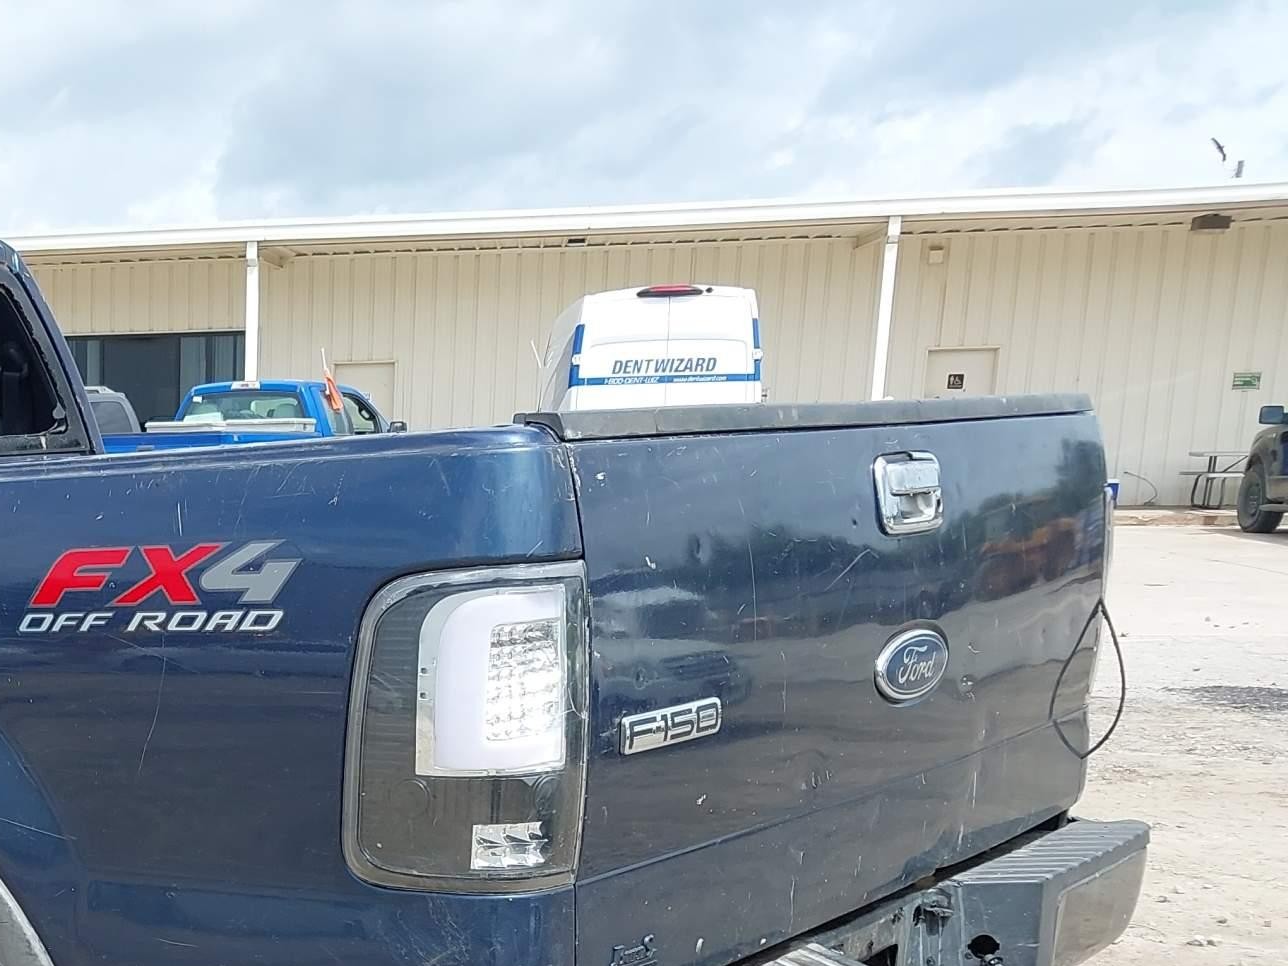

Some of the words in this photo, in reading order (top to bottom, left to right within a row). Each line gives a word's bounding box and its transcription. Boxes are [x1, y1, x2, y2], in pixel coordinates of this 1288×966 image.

[612, 358, 652, 374] DENT
[654, 357, 717, 373] WIZARD
[28, 539, 304, 608] FX4
[17, 611, 116, 632] OFF
[123, 610, 285, 632] ROAD
[897, 645, 936, 684] Ford
